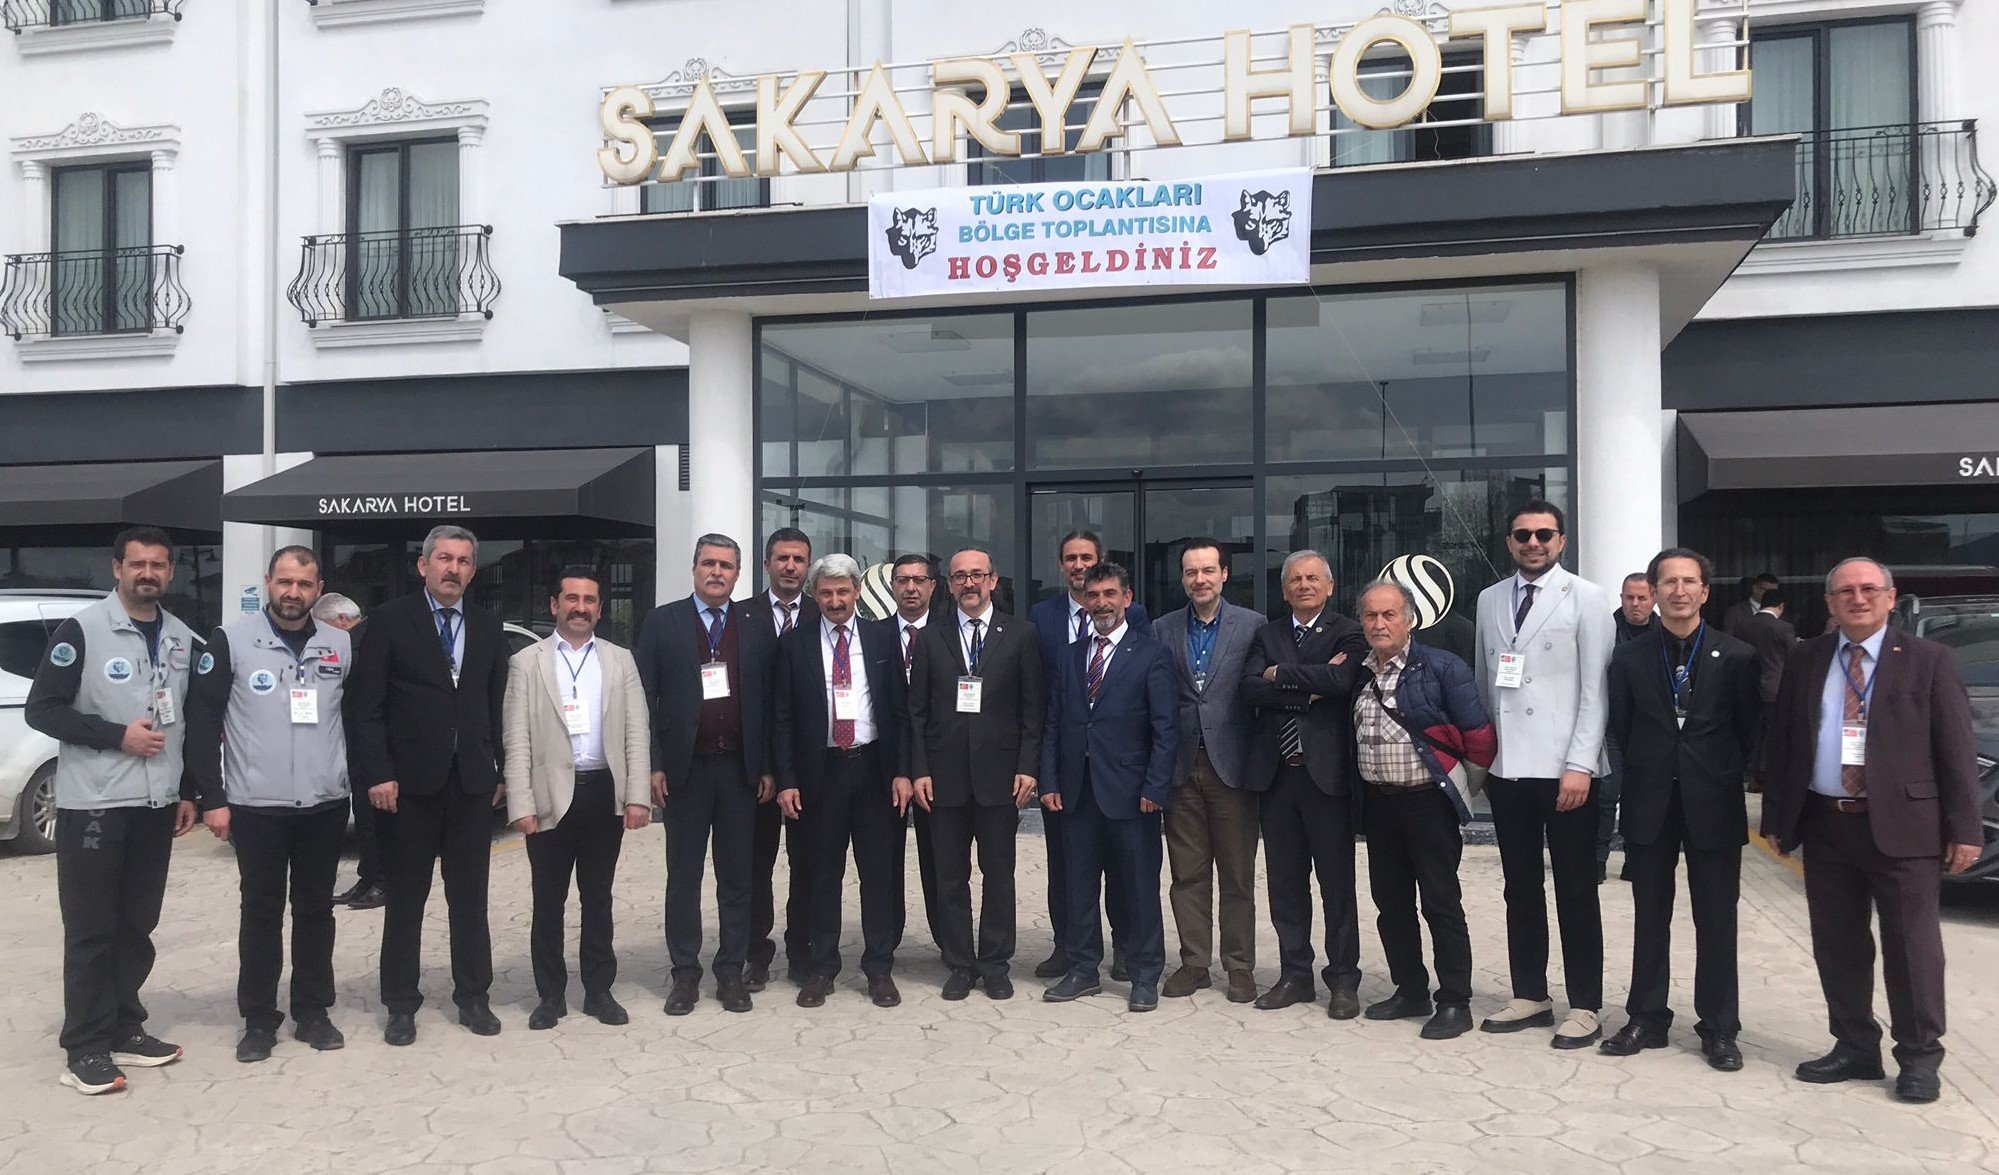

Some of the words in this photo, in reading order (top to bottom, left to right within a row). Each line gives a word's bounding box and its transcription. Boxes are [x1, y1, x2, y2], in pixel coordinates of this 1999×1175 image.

[597, 36, 1183, 185] SAKARYA
[1224, 0, 1752, 141] HOTEL
[969, 191, 1044, 216] TÜRK
[1053, 183, 1202, 211] OCAKLARI
[958, 219, 1036, 243] BÖLGE
[1041, 215, 1212, 239] TOPLANTISINA
[948, 241, 1217, 283] HOŞGELDİNİZ
[1958, 456, 1999, 477] SA
[318, 497, 398, 514] SAKARYA
[404, 495, 471, 512] HOTEL
